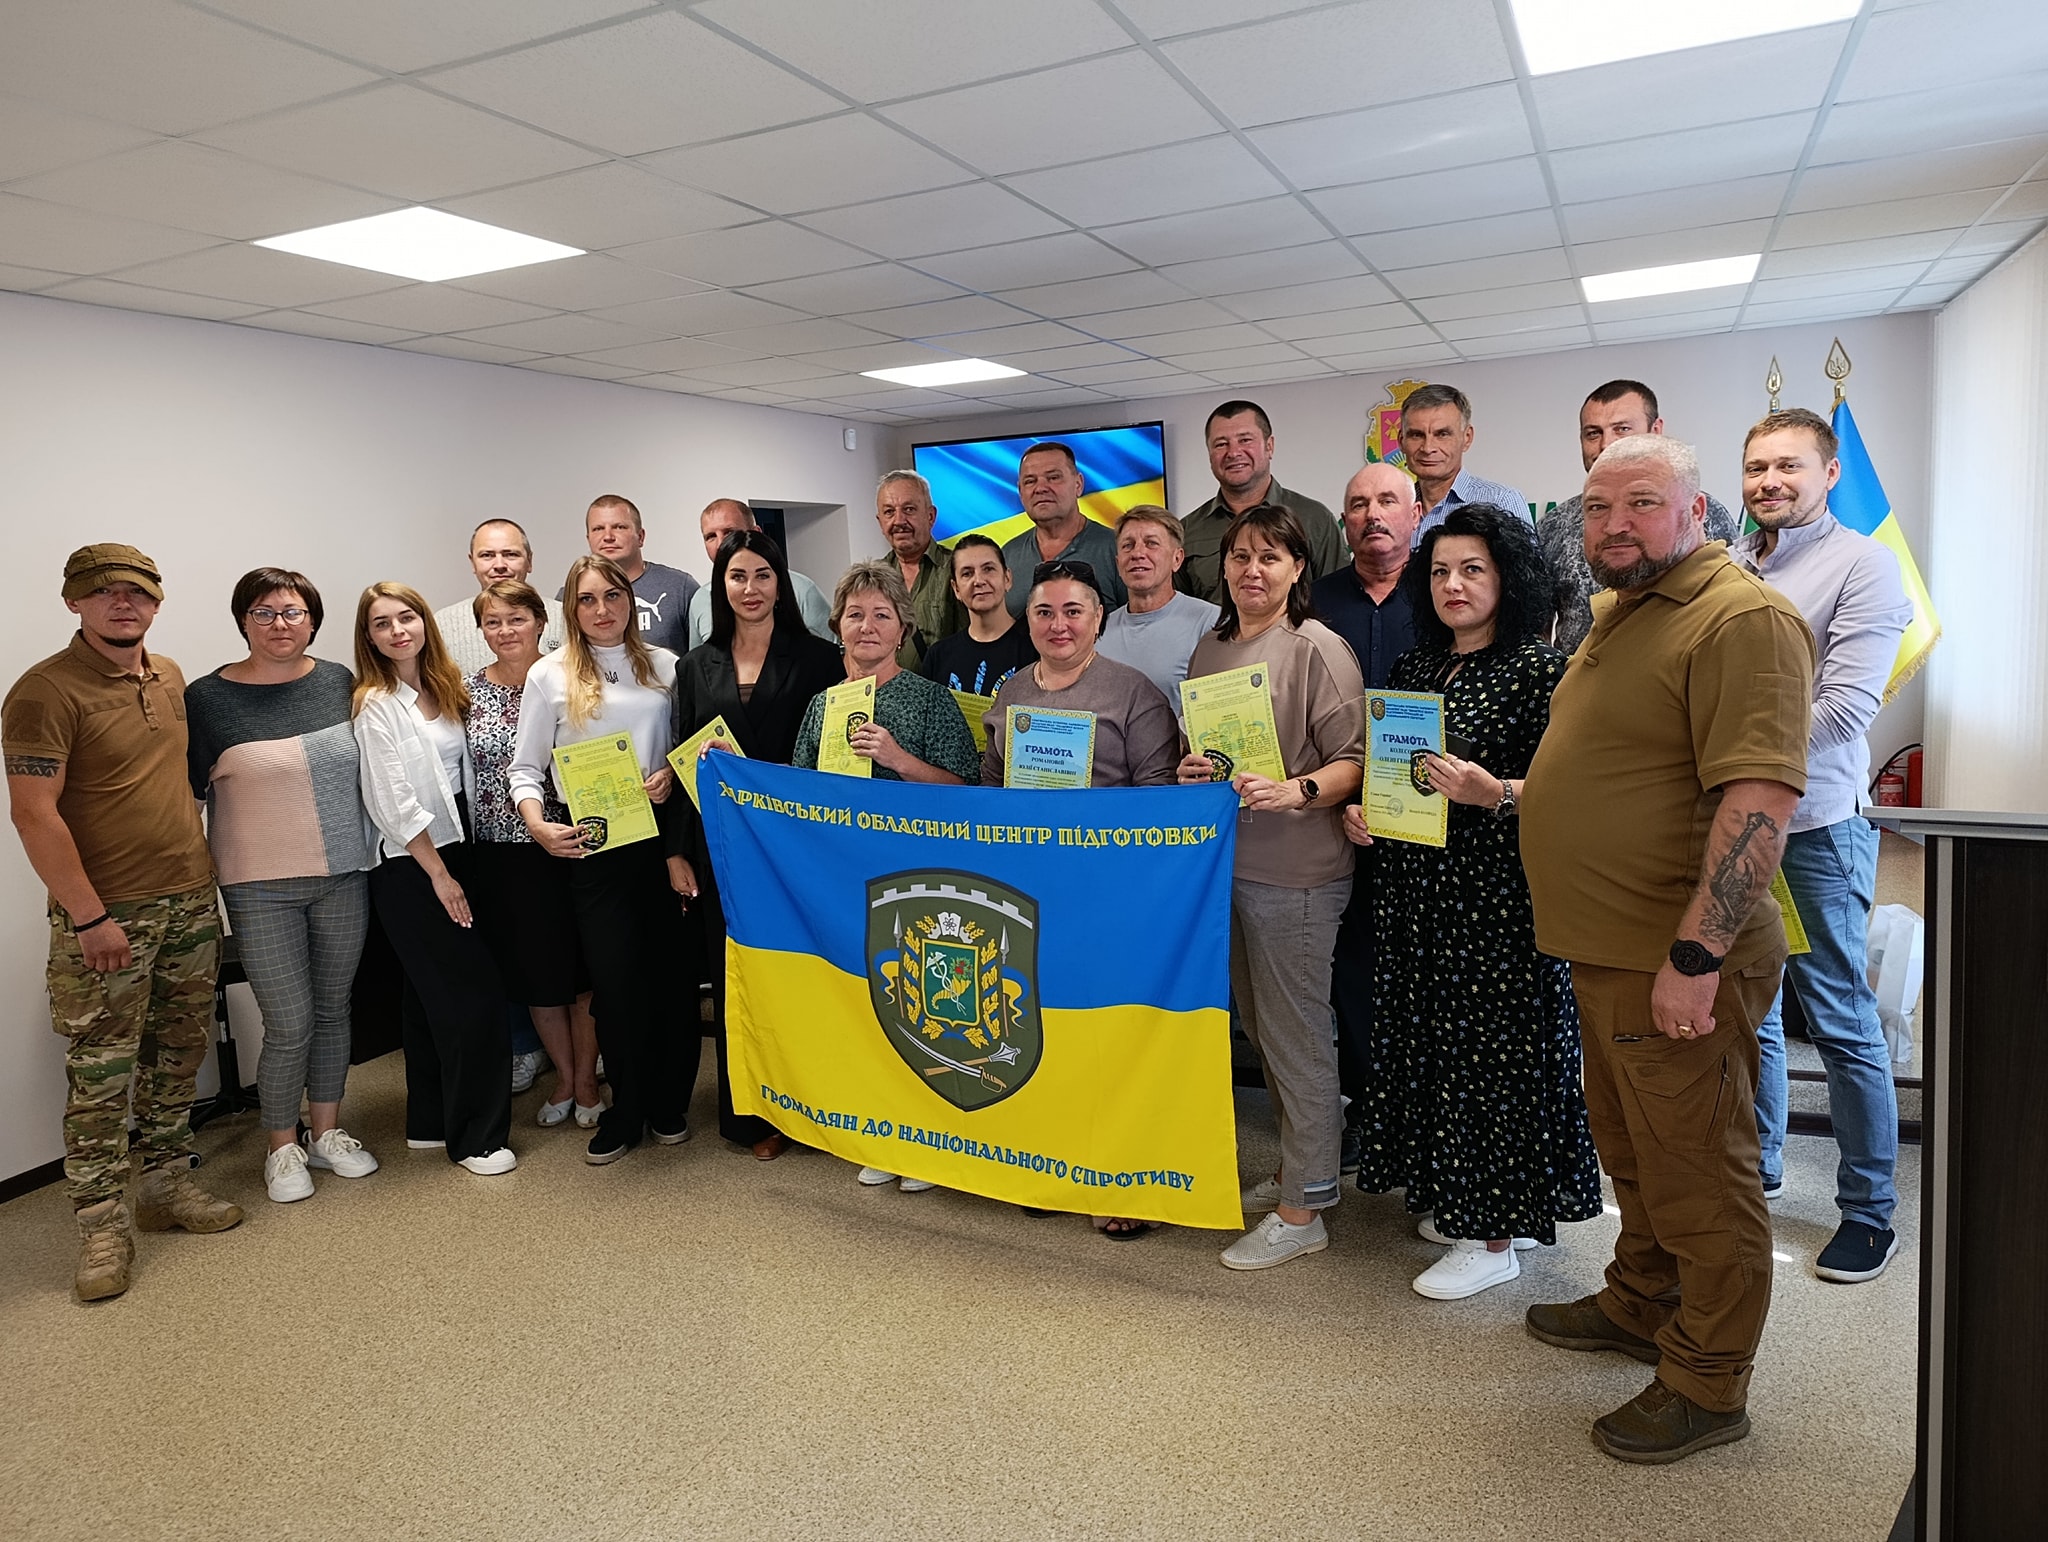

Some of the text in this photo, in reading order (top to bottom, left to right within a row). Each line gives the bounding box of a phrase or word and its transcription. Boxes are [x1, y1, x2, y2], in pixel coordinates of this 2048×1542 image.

[1025, 744, 1074, 758] ГРАМОТА
[1382, 733, 1429, 747] ГРАМОТА
[718, 781, 1217, 849] ХАРКІВСЬКИЙ ОБЛАСНИЙ ЦЕНТР ПІДГОТОВКИ
[760, 1084, 1194, 1192] ГРОМАДЯН ДО НАЦІОНАЛЬНОГО СПРОТИВУ
